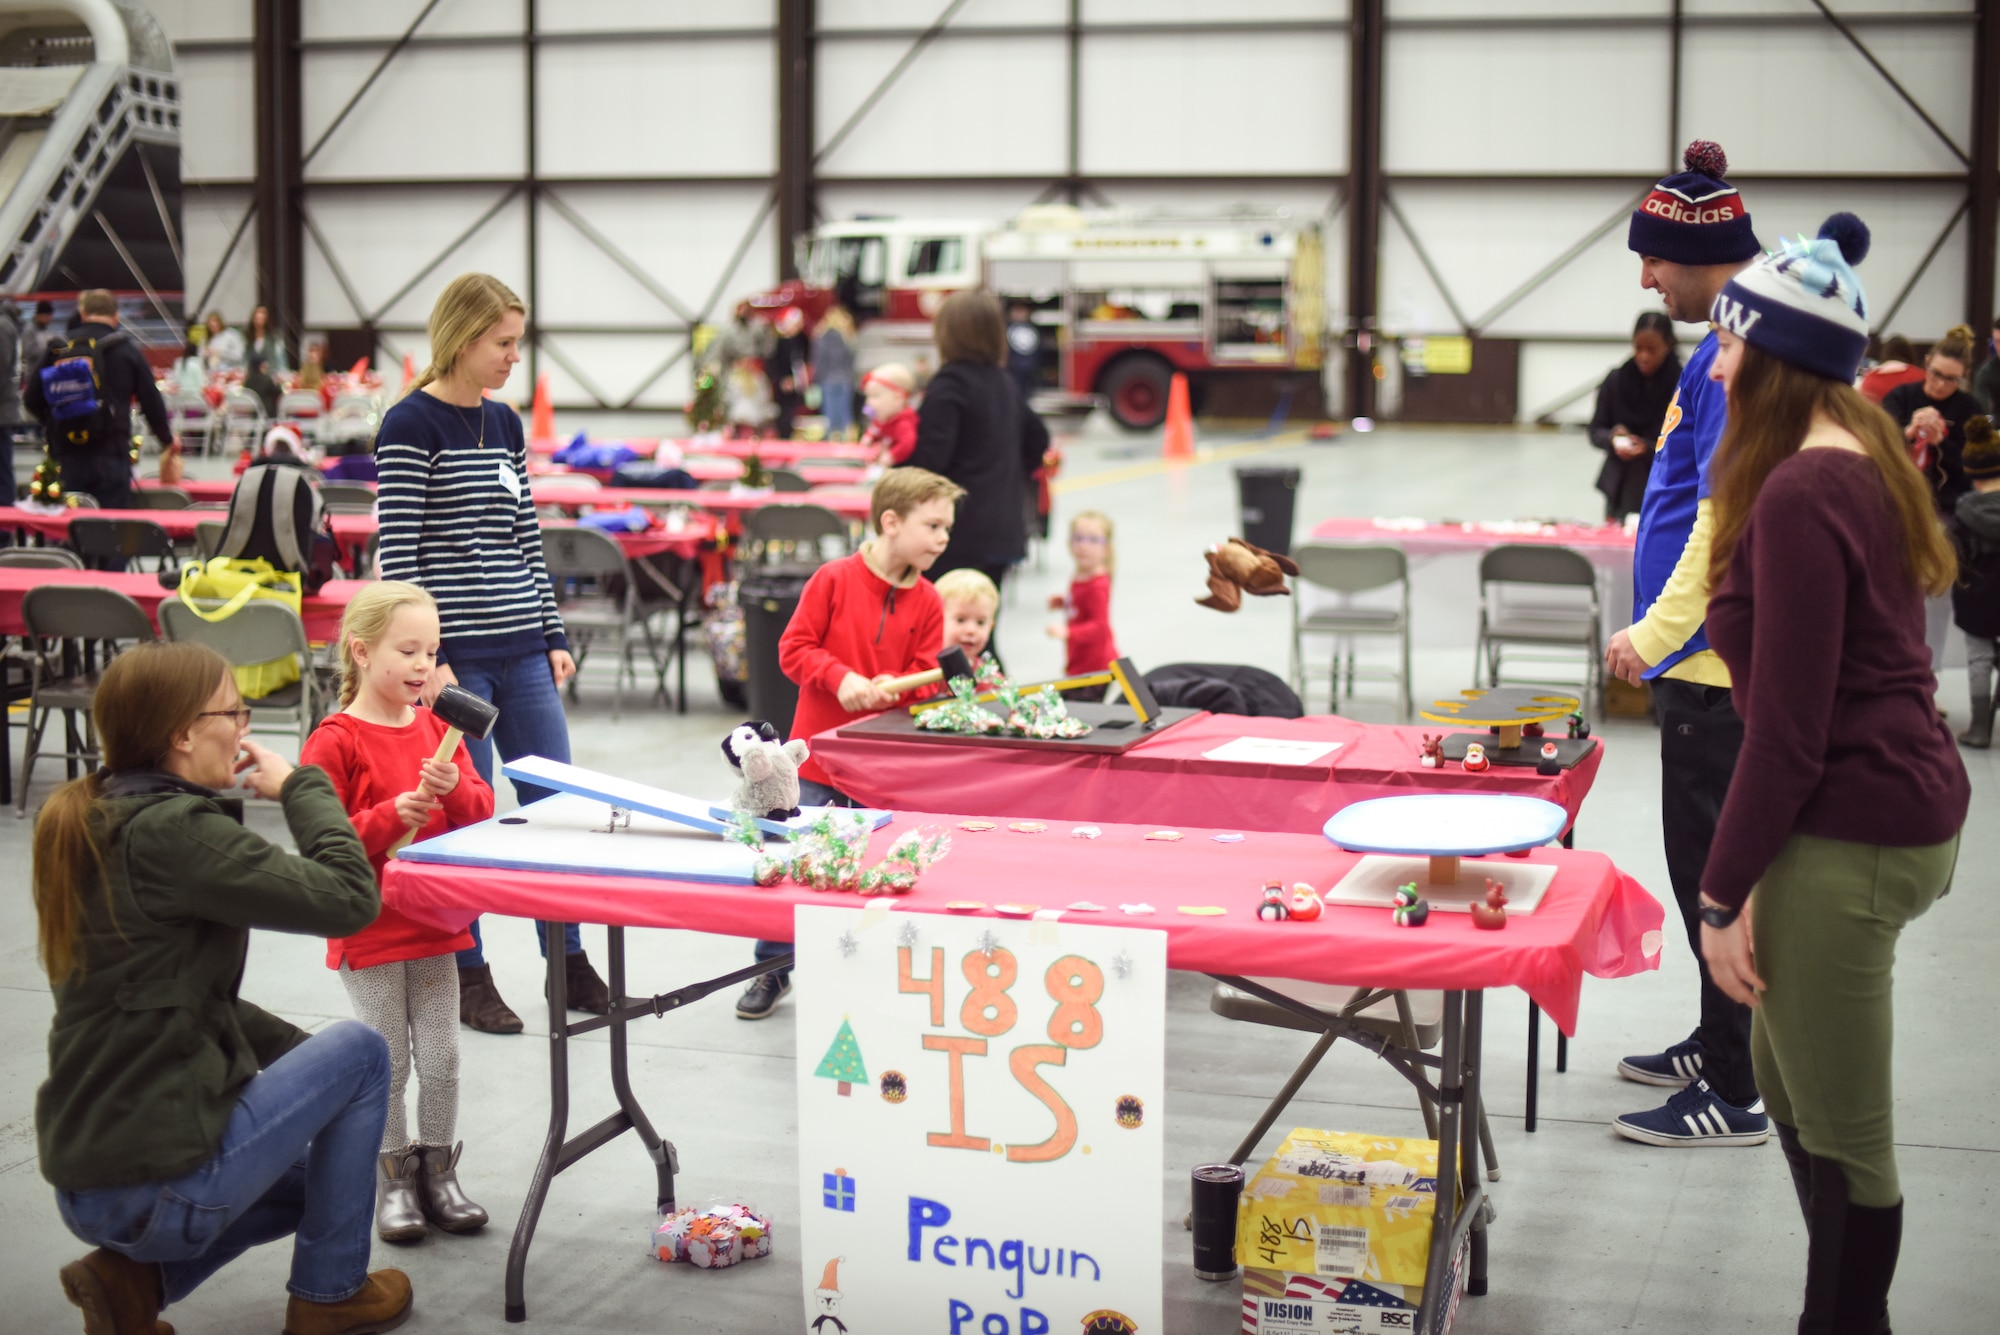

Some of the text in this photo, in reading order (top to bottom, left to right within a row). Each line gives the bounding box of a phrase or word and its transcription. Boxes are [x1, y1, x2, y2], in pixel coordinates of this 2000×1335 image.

[1645, 198, 1735, 224] adidas
[897, 945, 1104, 1050] 488
[907, 1195, 1101, 1300] Penguin
[1257, 1214, 1288, 1264] 488
[1264, 1302, 1313, 1321] VISION
[1380, 1311, 1411, 1326] BSC
